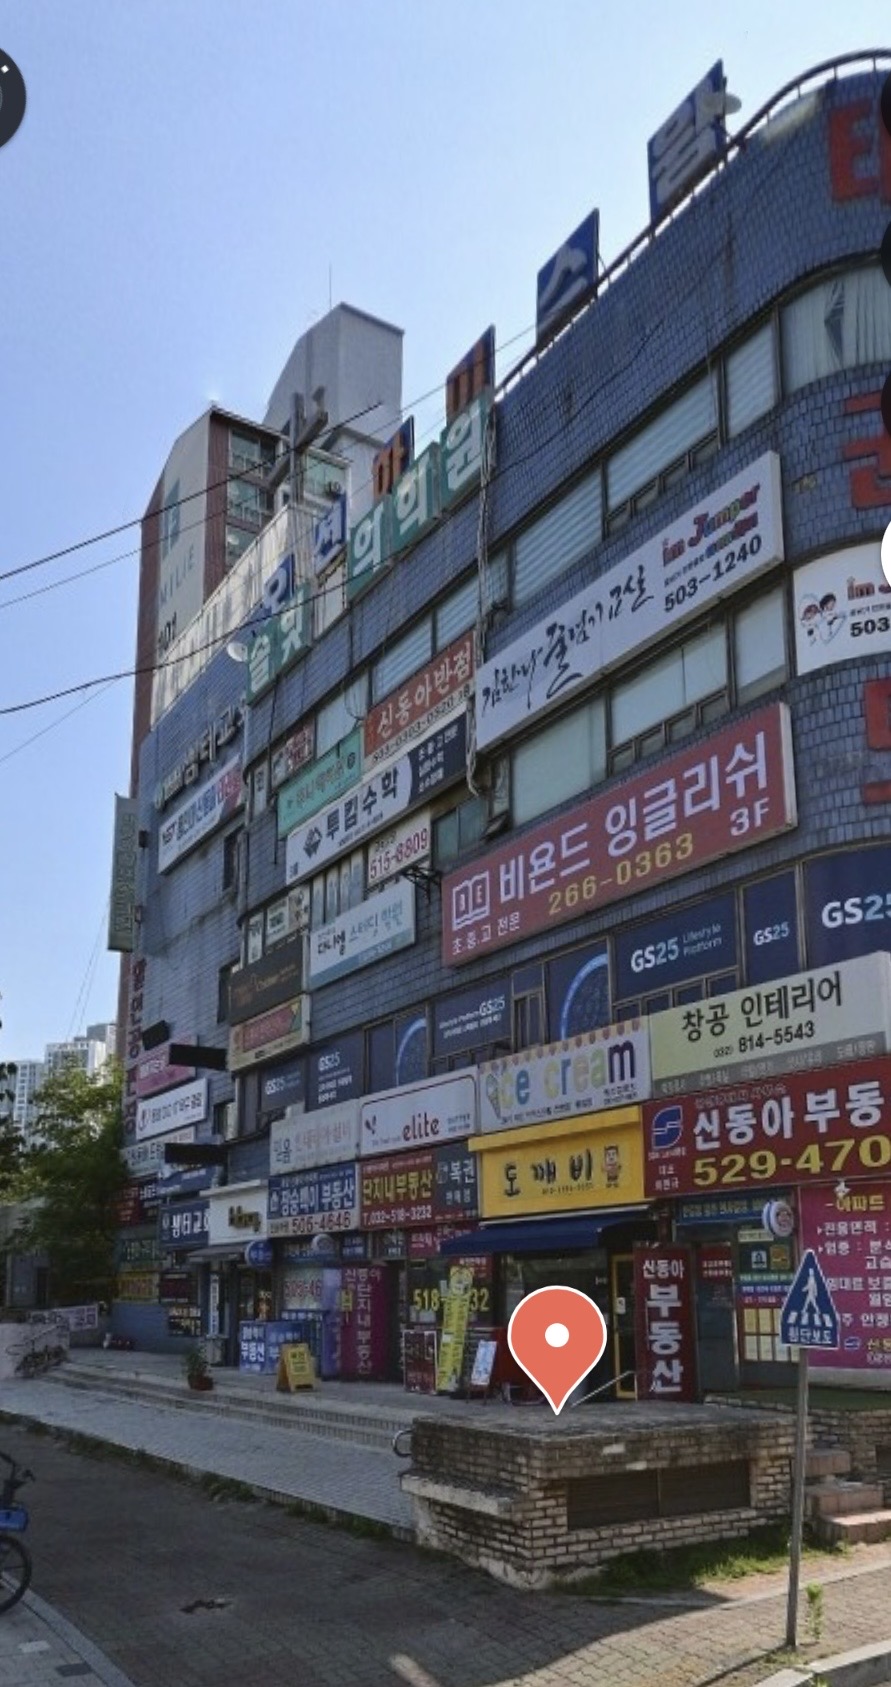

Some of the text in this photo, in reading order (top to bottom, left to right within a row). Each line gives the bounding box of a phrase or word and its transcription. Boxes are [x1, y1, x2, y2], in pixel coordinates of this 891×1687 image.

[664, 533, 763, 614] 503-1240
[377, 641, 472, 739] 신동아반점
[499, 823, 591, 904] 비욘드
[605, 731, 768, 859] 잉글리쉬
[730, 797, 771, 837] 3F
[549, 832, 694, 916] 266-0363
[497, 911, 521, 936] 전문
[821, 894, 891, 930] GS2
[753, 921, 790, 947] GS25
[630, 937, 680, 974] GS25
[479, 994, 506, 1016] GS25
[682, 970, 843, 1042] 창공 인테리어
[738, 1020, 816, 1054] 814-5543
[547, 1040, 645, 1104] cream
[402, 1111, 440, 1142] elite
[693, 1095, 796, 1152] 신동아
[504, 1147, 594, 1198] 도깨비
[693, 1134, 891, 1186] 529-470
[321, 1177, 355, 1211] 부동산
[363, 1168, 433, 1206] 단지내부동산
[643, 1259, 684, 1279] 신동아
[646, 1284, 683, 1394] 부동산
[788, 1326, 833, 1345] 횡단보도
